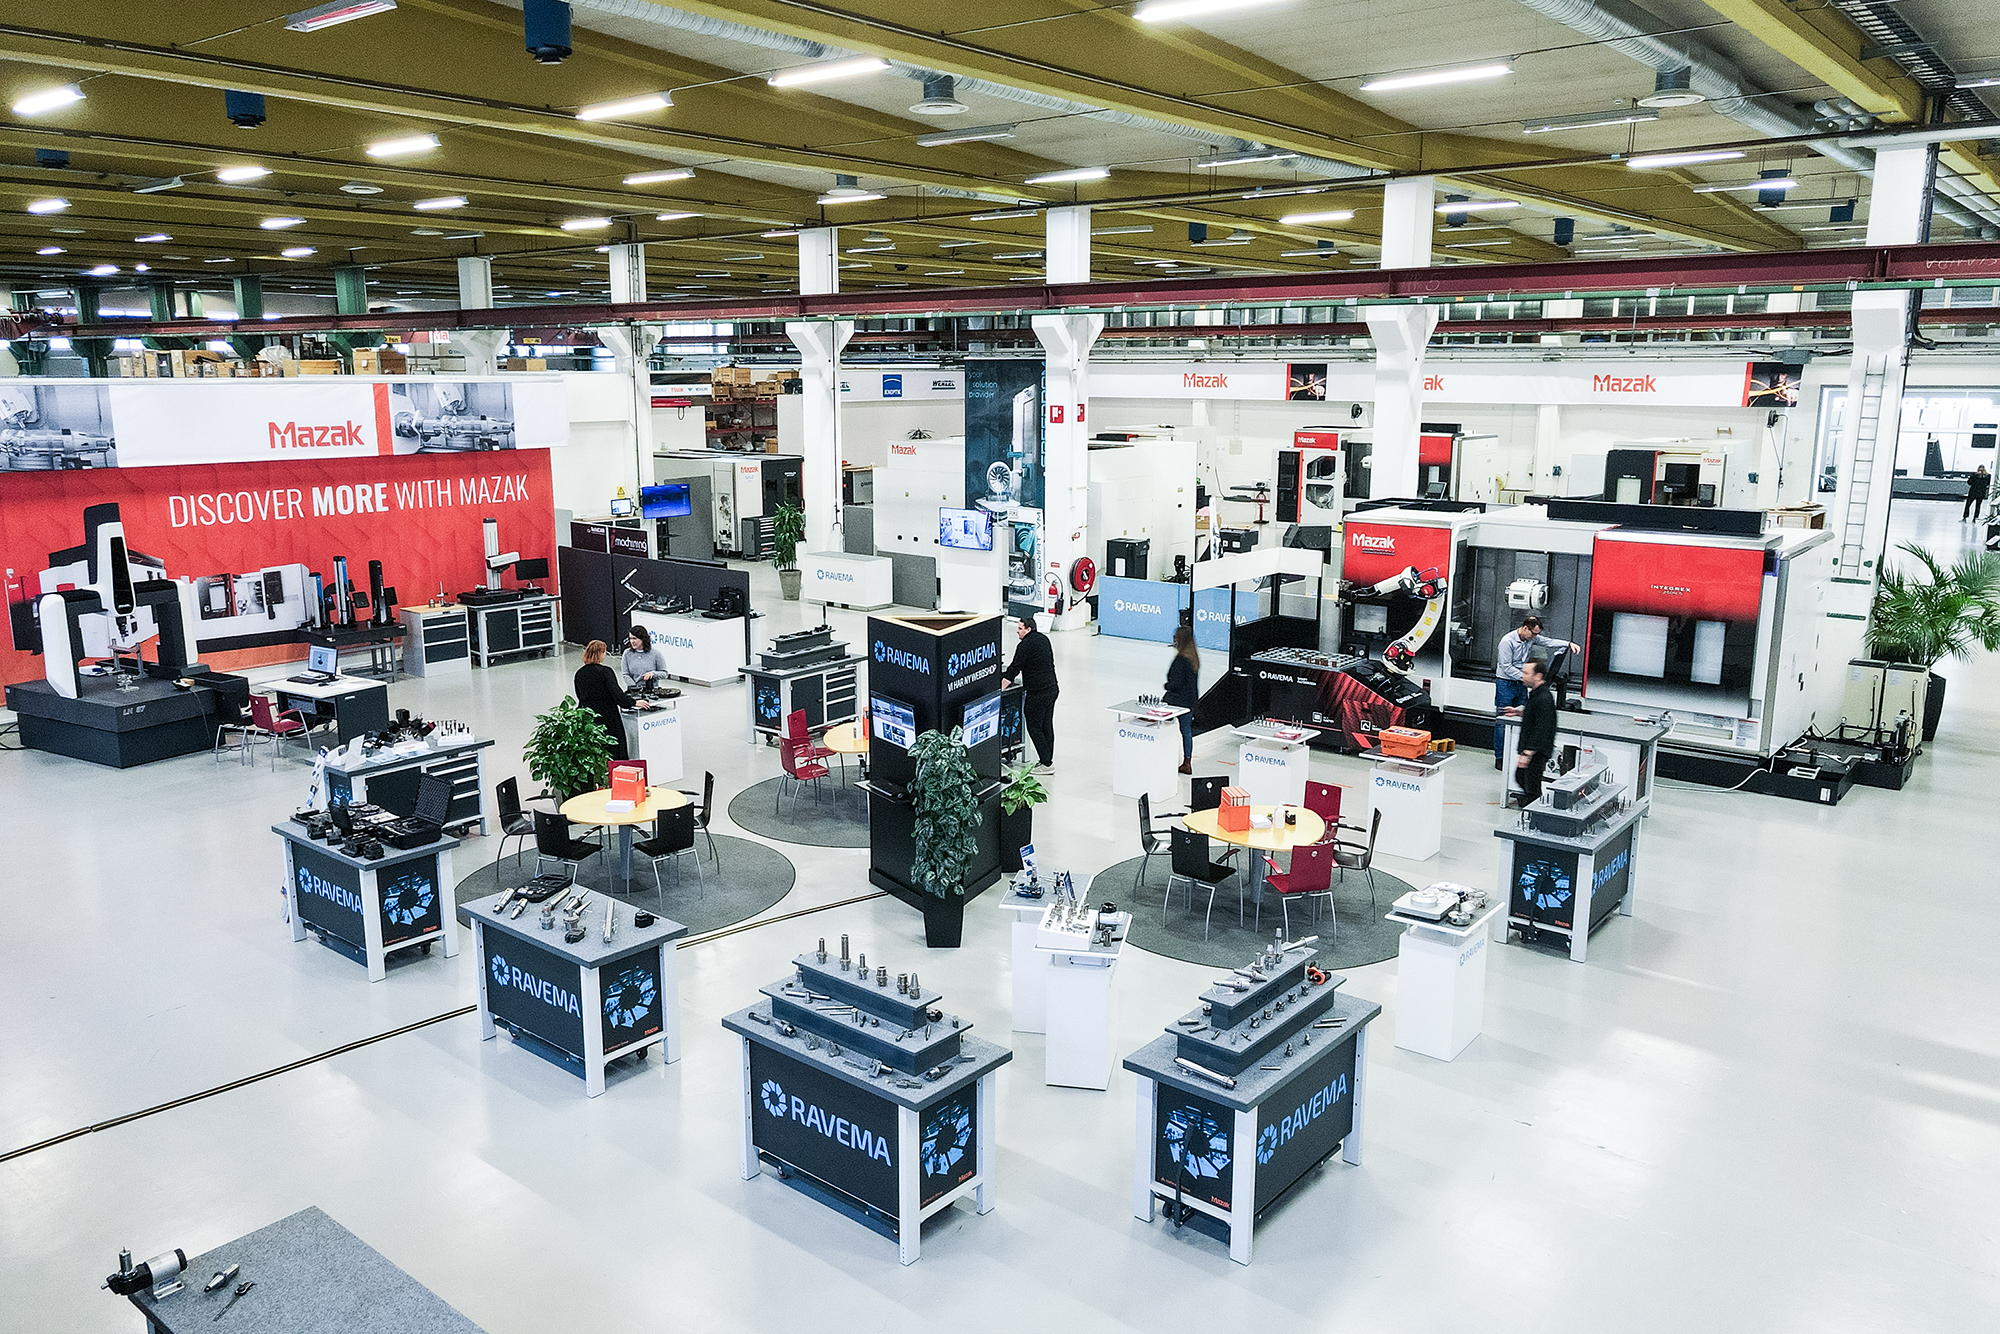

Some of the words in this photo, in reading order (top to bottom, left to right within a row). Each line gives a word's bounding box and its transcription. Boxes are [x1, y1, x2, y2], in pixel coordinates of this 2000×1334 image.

[1183, 373, 1228, 388] Mazak
[1593, 375, 1657, 393] Mazak
[268, 420, 366, 449] Mazak
[892, 444, 917, 455] Mazak
[741, 466, 759, 474] Mazak
[168, 487, 306, 528] DISCOVER
[311, 482, 390, 518] MORE
[394, 479, 453, 510] WITH
[459, 474, 530, 505] MAZAK
[1352, 533, 1395, 549] Mazak
[825, 570, 854, 584] RAVEMA
[1650, 584, 1692, 593] INTEGREX
[1125, 602, 1162, 615] RAVEMA
[658, 633, 694, 650] RAVEMA
[887, 646, 931, 676] RAVEMA
[960, 641, 998, 670] RAVEMA
[953, 677, 964, 690] HAR
[971, 663, 998, 683] WEBBSHOP
[1267, 672, 1294, 683] RAVEMA
[651, 716, 677, 730] RAVEMA
[1126, 731, 1156, 743] RAVEMA
[1255, 755, 1287, 768] RAVEMA
[1385, 779, 1421, 793] RAVEMA
[1597, 849, 1628, 889] RAVEMA
[313, 873, 365, 916] RAVEMA
[1465, 938, 1485, 962] RAVEMA
[512, 965, 582, 1019] RAVEMA
[1280, 1070, 1348, 1144] RAVEMA
[790, 1094, 893, 1168] RAVEMA
[1211, 1195, 1231, 1209] Mazak
